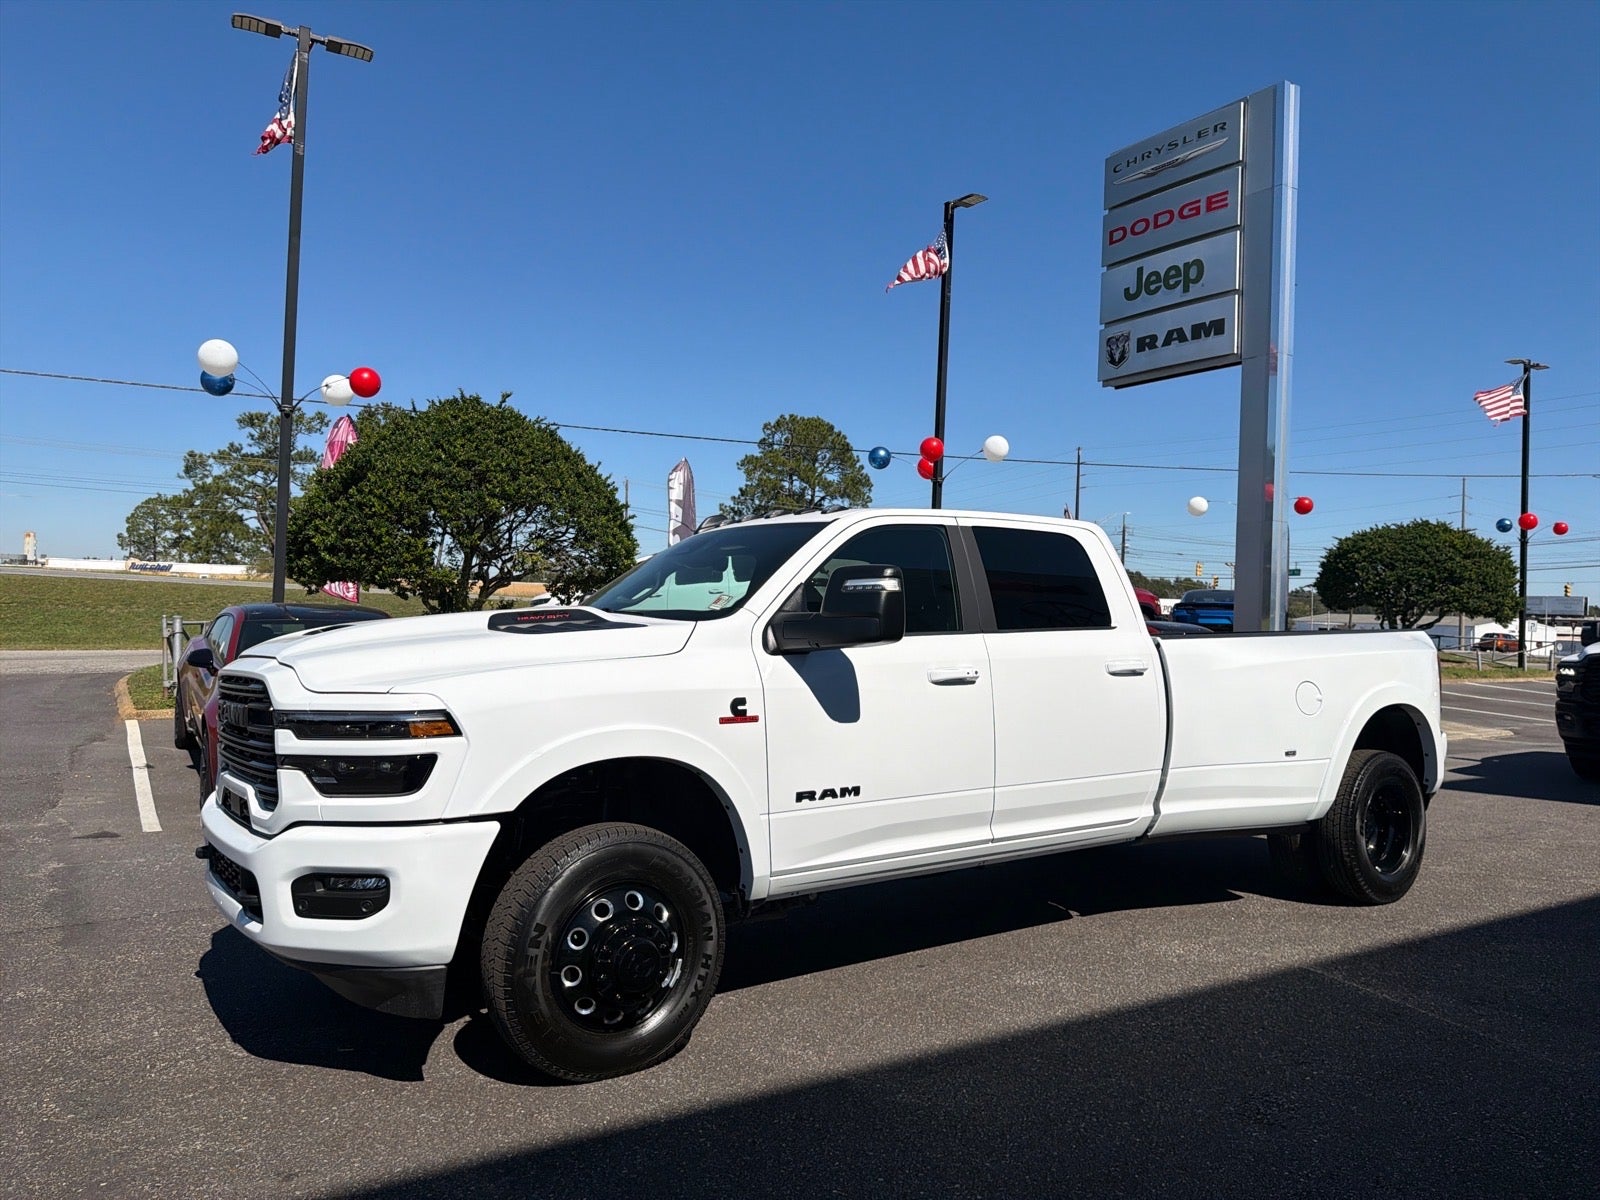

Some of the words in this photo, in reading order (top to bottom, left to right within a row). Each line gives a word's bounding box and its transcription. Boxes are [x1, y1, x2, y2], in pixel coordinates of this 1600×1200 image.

[1113, 120, 1228, 174] CHRYSLER
[1108, 190, 1229, 246] DODGE
[1123, 257, 1205, 301] Jeep
[1135, 317, 1226, 354] RAM
[795, 785, 861, 803] RAM
